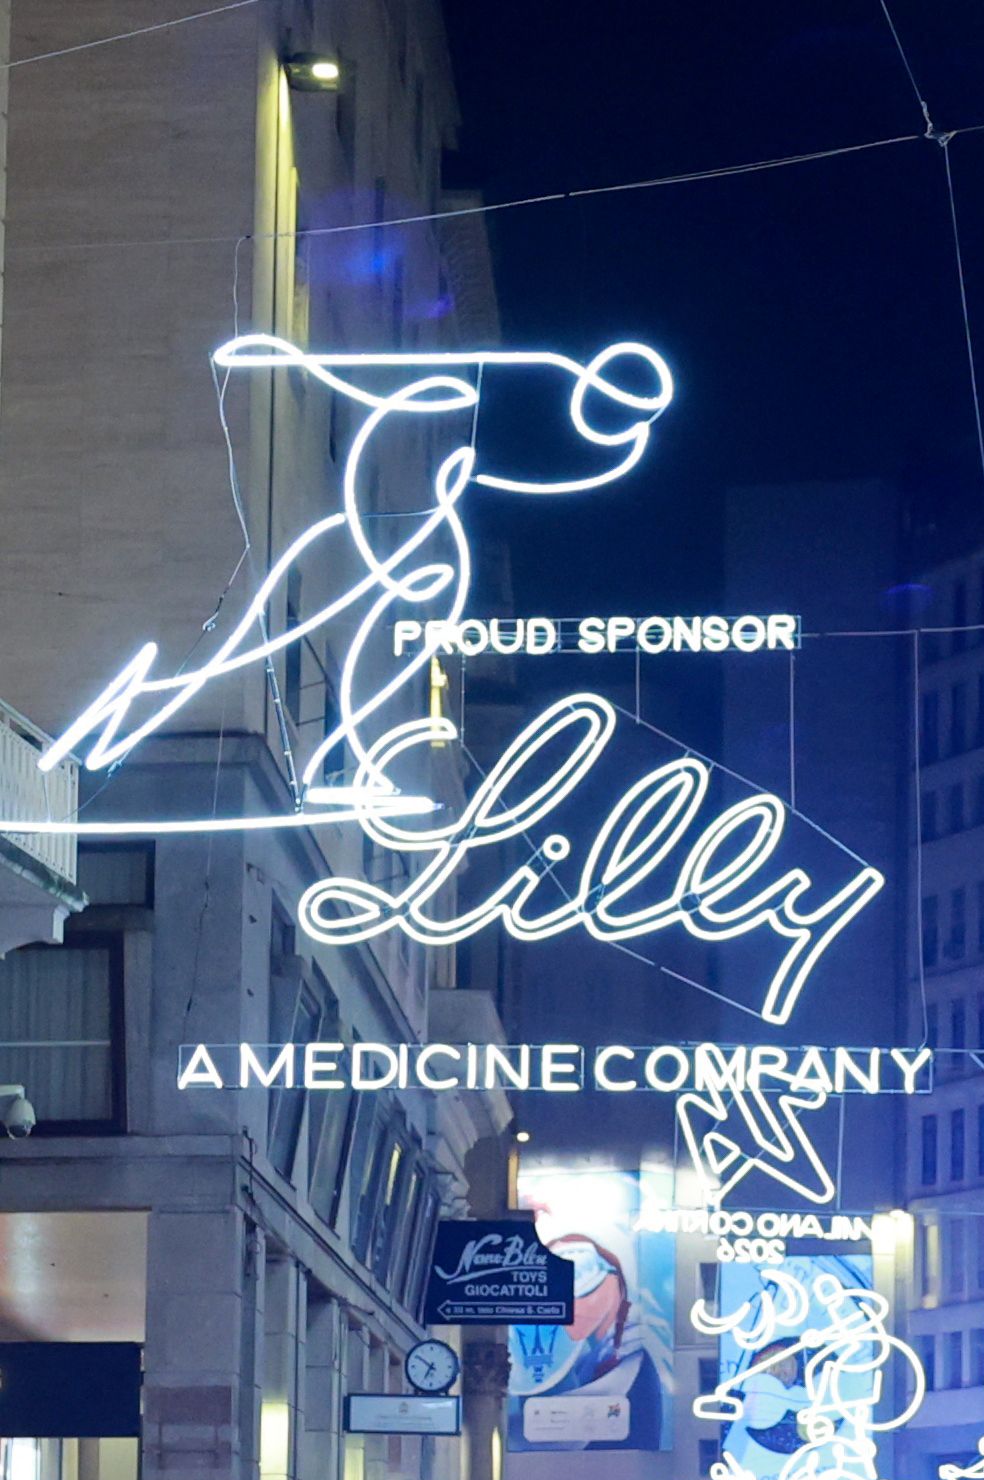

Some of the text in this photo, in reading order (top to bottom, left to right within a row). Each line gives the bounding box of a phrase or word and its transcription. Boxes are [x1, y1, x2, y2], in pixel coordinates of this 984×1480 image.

[393, 613, 797, 656] PROUD SPONSOR
[299, 692, 884, 1025] Lilly
[178, 1042, 932, 1096] A MEDICINE COMPANY
[465, 1285, 548, 1296] GIOCATTOLI
[512, 1271, 547, 1282] TOYS
